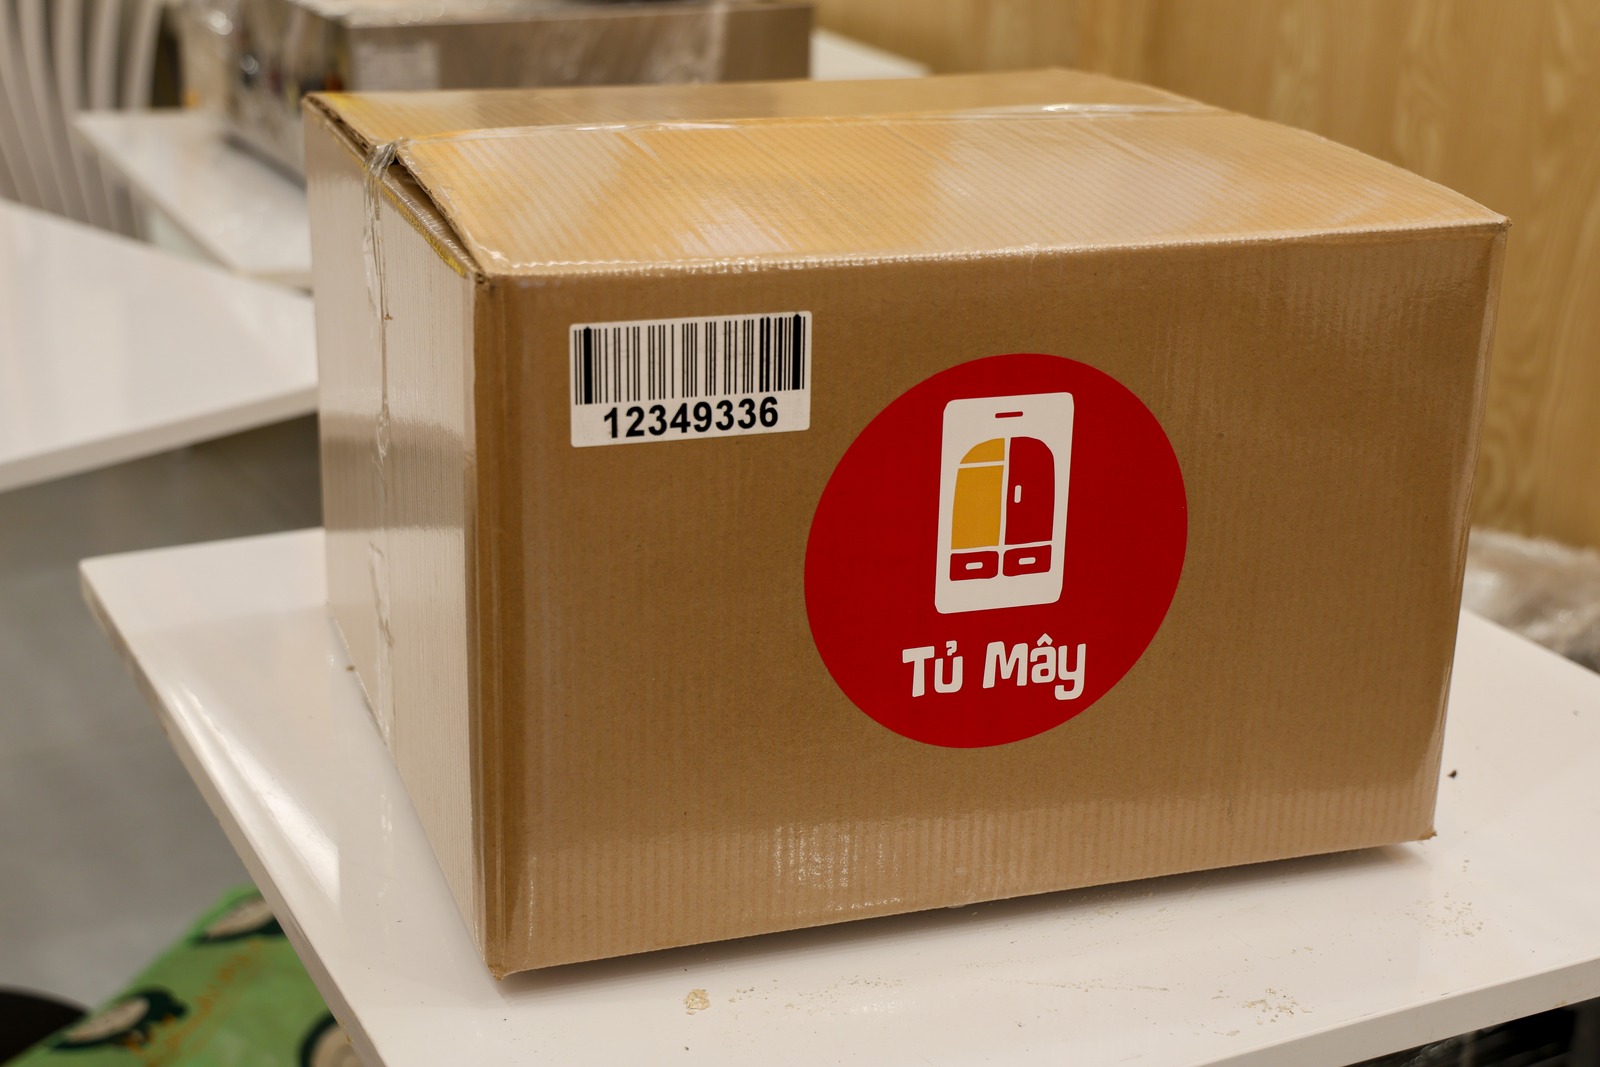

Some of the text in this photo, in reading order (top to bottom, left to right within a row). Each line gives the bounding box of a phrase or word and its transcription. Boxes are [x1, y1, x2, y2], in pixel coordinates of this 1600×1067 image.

[603, 396, 779, 438] 12349336
[902, 632, 1086, 700] Tủ Mây
